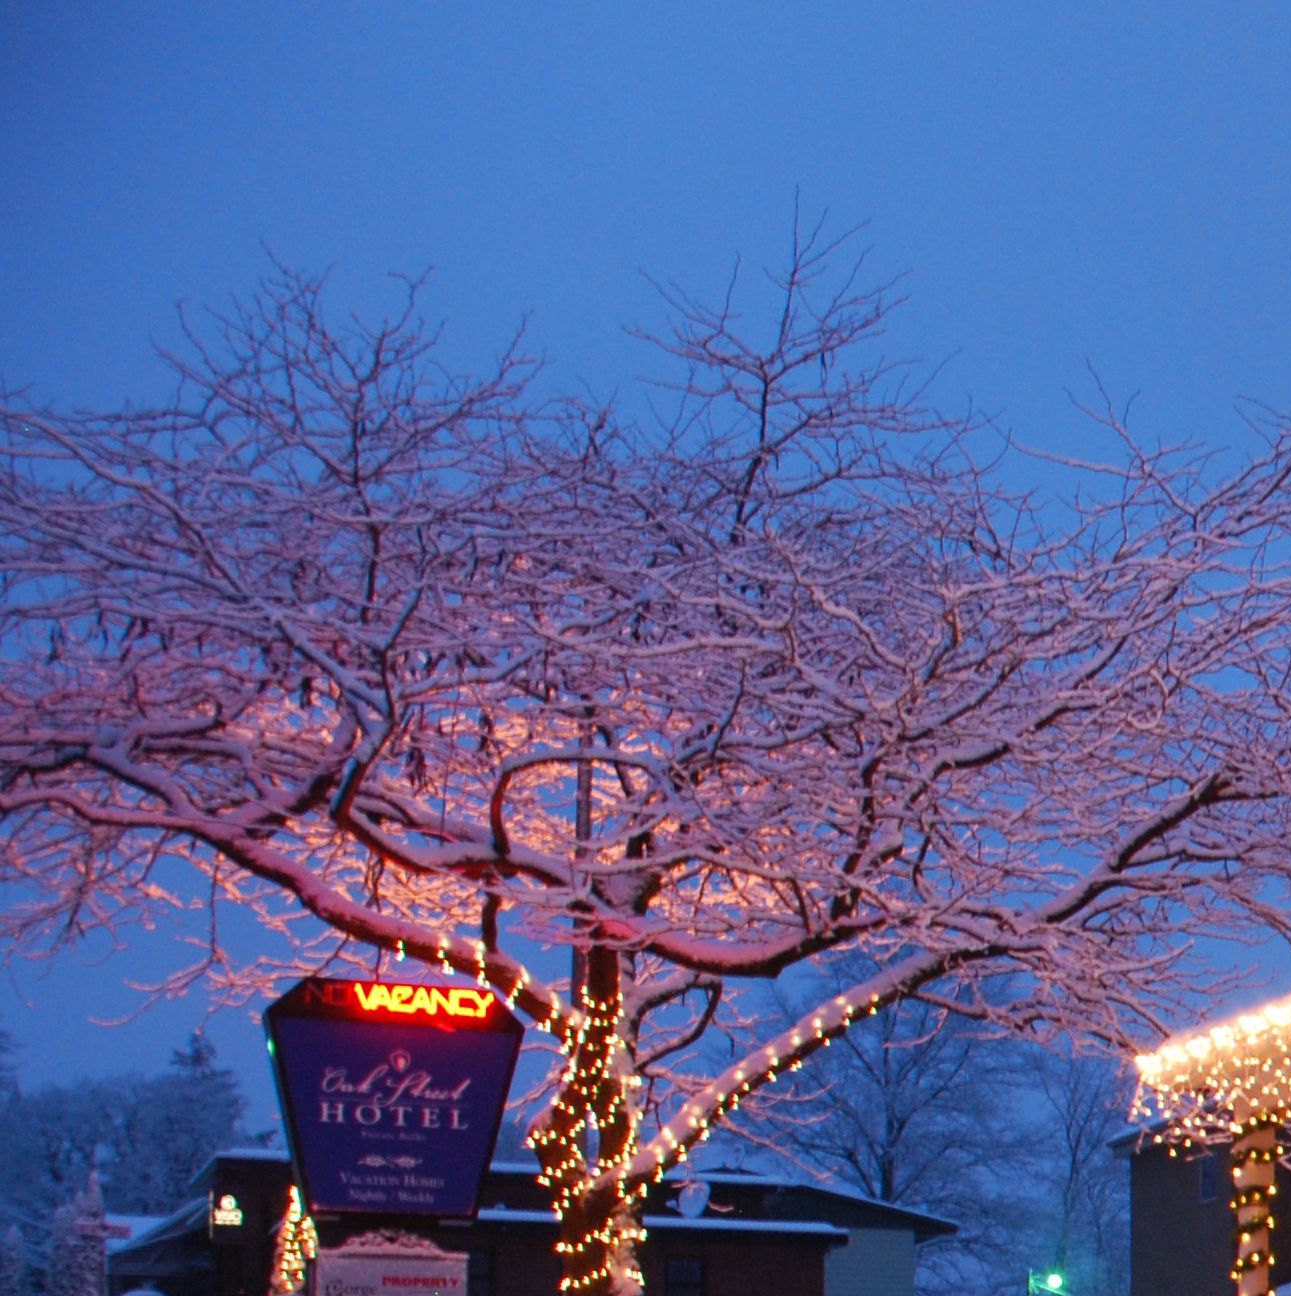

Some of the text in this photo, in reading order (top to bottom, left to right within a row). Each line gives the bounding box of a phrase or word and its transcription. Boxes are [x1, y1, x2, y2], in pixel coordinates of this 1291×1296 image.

[354, 982, 494, 1018] VACANCY
[321, 1064, 471, 1108] Oak Street
[319, 1101, 469, 1130] HOTEL
[381, 1275, 459, 1289] PROPERTY
